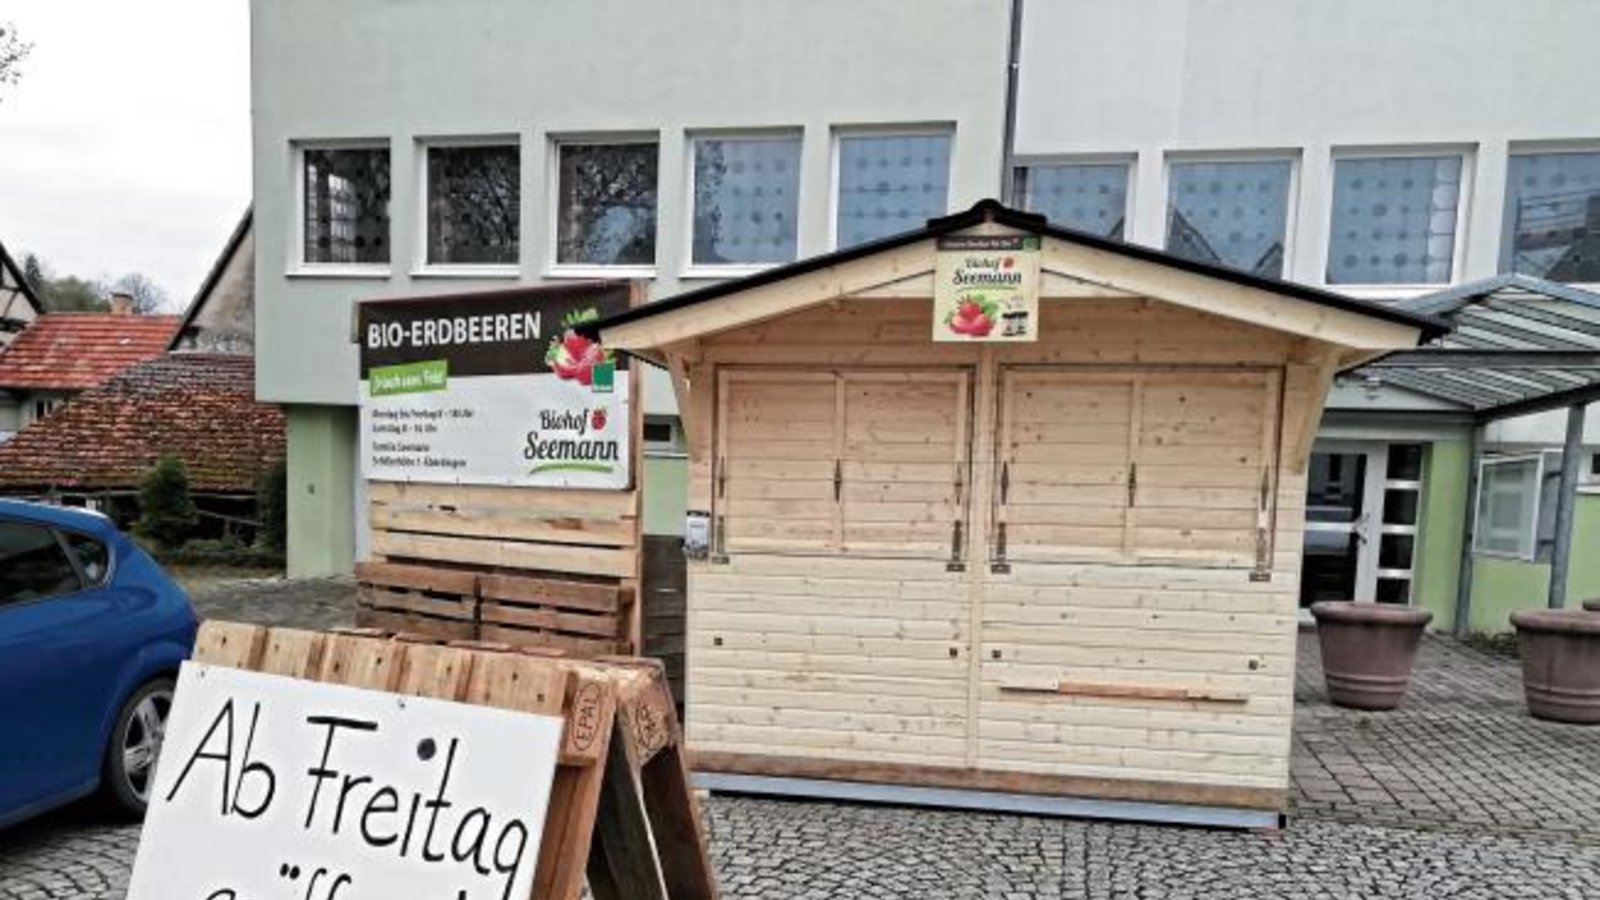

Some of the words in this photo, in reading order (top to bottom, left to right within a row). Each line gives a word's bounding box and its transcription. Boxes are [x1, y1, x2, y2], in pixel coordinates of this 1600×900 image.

[952, 269, 1022, 285] Seemann
[367, 311, 542, 348] BIO-ERDBEEREN
[539, 407, 589, 436] Biohof
[523, 431, 619, 460] Seemann
[166, 697, 276, 820] Ab
[304, 715, 529, 900] Freitag
